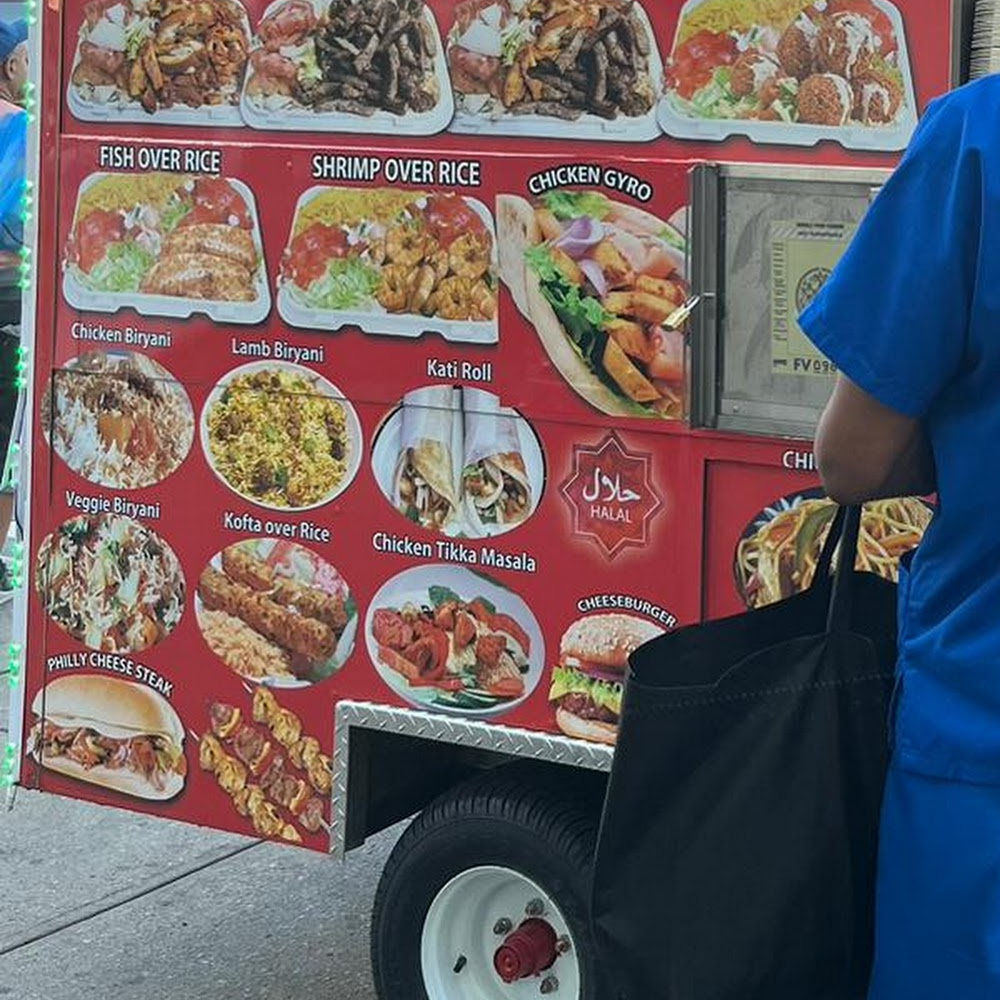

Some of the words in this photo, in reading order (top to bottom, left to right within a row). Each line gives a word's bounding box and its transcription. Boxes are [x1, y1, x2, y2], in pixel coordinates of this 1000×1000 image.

[100, 146, 135, 169] FISH
[138, 148, 181, 171] OVER
[184, 150, 221, 173] RICE
[312, 155, 381, 183] SHRIMP
[385, 158, 434, 184] OVER
[438, 161, 480, 186] RICE
[528, 166, 600, 195] CHICKEN
[603, 168, 653, 201] GYRO
[71, 322, 122, 344] Chicken
[124, 326, 171, 349] Biryani
[232, 339, 271, 358] Lamb
[274, 342, 324, 362] Biryani
[427, 359, 459, 379] Kati
[461, 361, 492, 382] Roll
[783, 451, 818, 471] CHI
[582, 467, 641, 502] حلال
[65, 490, 111, 513] Veggie
[113, 499, 160, 521] Biryani
[590, 507, 632, 525] HALAL
[224, 512, 263, 534] Kofta
[265, 521, 297, 537] over
[300, 523, 331, 543] Rice
[372, 531, 432, 556] Chicken
[436, 540, 477, 564] Tikka
[481, 546, 537, 573] Masala
[577, 594, 677, 628] CHEESEBURGER
[47, 651, 88, 673] PHILLY
[90, 652, 135, 677] CHEESE
[135, 662, 174, 698] STEAK
